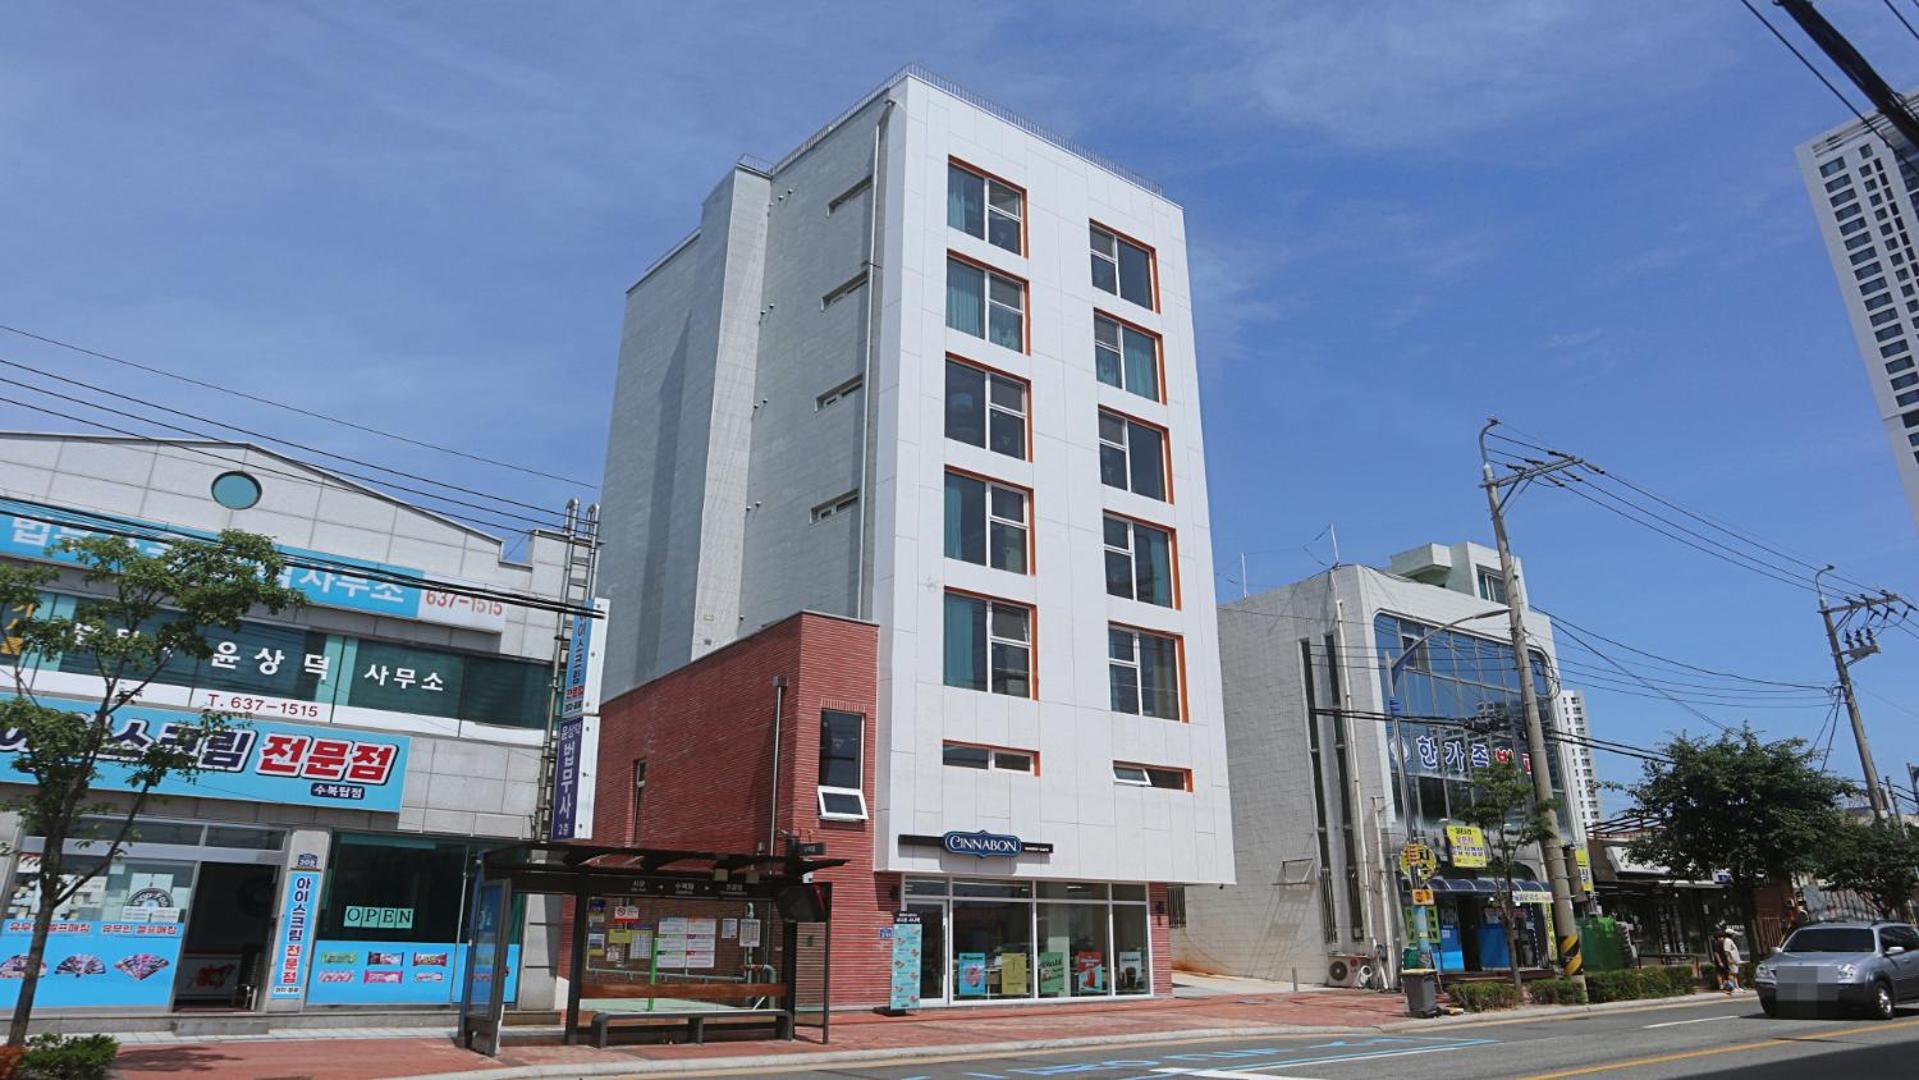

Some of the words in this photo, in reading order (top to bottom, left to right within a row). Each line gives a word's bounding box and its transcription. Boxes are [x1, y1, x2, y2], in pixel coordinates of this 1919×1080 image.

[425, 588, 504, 616] 637-1515
[364, 664, 444, 692] 사무소
[230, 696, 319, 718] 637-1515
[258, 734, 396, 783] 전문점
[1416, 736, 1489, 772] 한가족
[559, 740, 576, 820] 법무사
[950, 836, 1017, 852] CINNABON
[288, 877, 312, 942] 아이스크림
[347, 908, 413, 924] OPEN
[283, 944, 301, 985] 전문점
